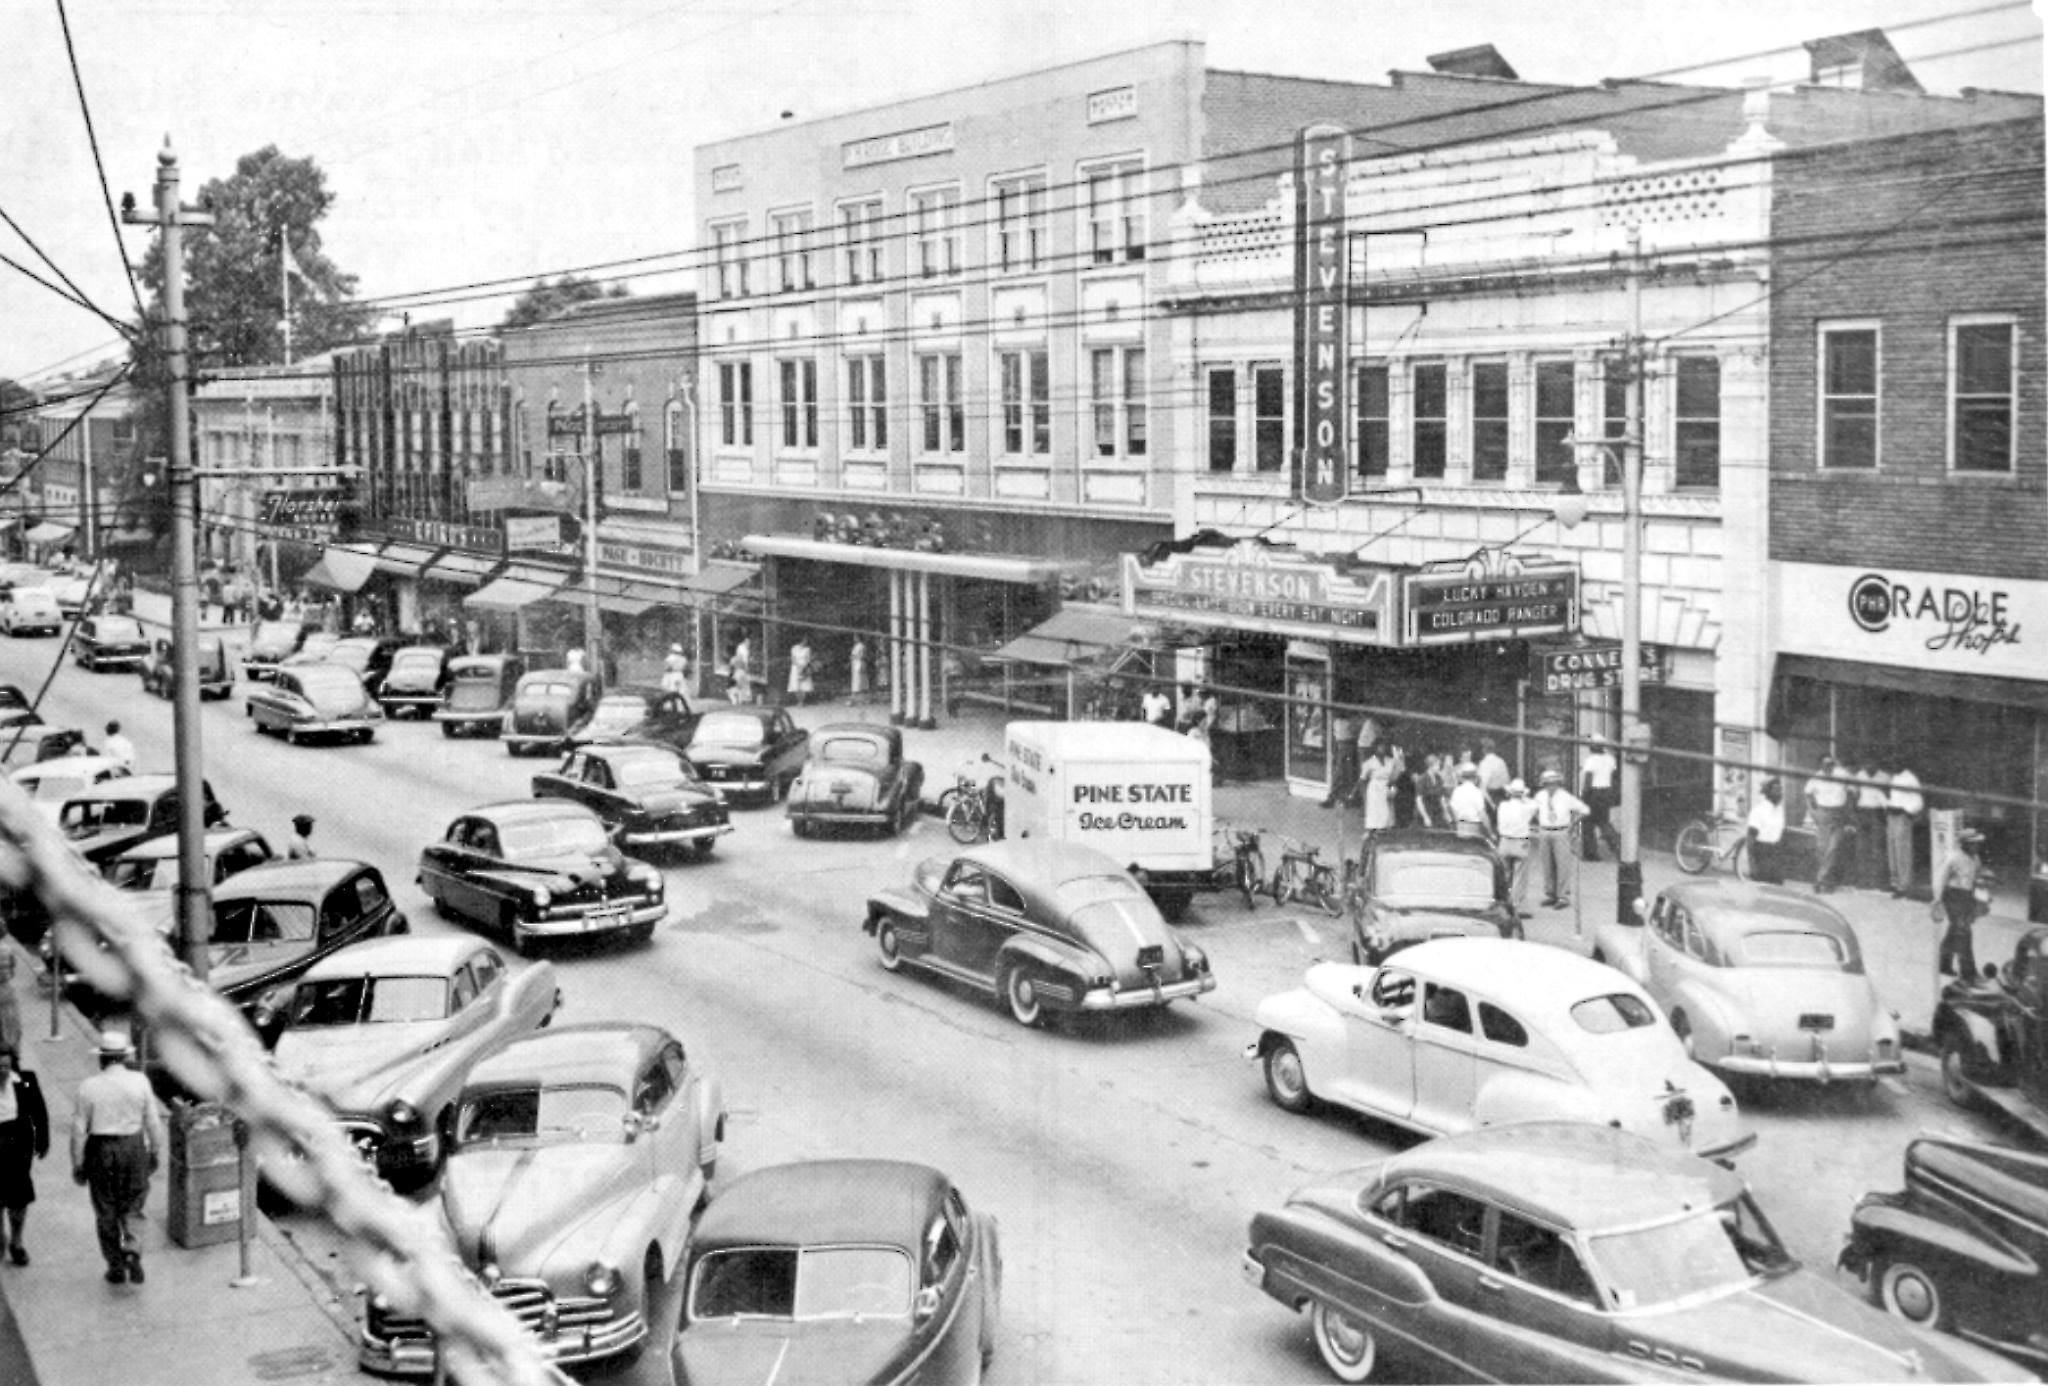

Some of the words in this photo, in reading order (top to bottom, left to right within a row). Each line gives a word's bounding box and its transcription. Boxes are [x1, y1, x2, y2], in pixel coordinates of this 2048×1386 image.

[1317, 147, 1337, 485] STEVENSON
[1191, 567, 1310, 599] STEVENSON
[1443, 585, 1487, 602] LUCKY
[1848, 573, 2009, 632] CRADLE
[1432, 608, 1500, 628] COLORADO
[1507, 604, 1558, 624] RANGER
[1547, 671, 1597, 691] DRUG
[1603, 667, 1660, 687] STRE
[1073, 784, 1123, 803] PINE
[1128, 784, 1192, 803] STATE
[1079, 812, 1117, 830] Ice
[1118, 812, 1188, 830] Cream
